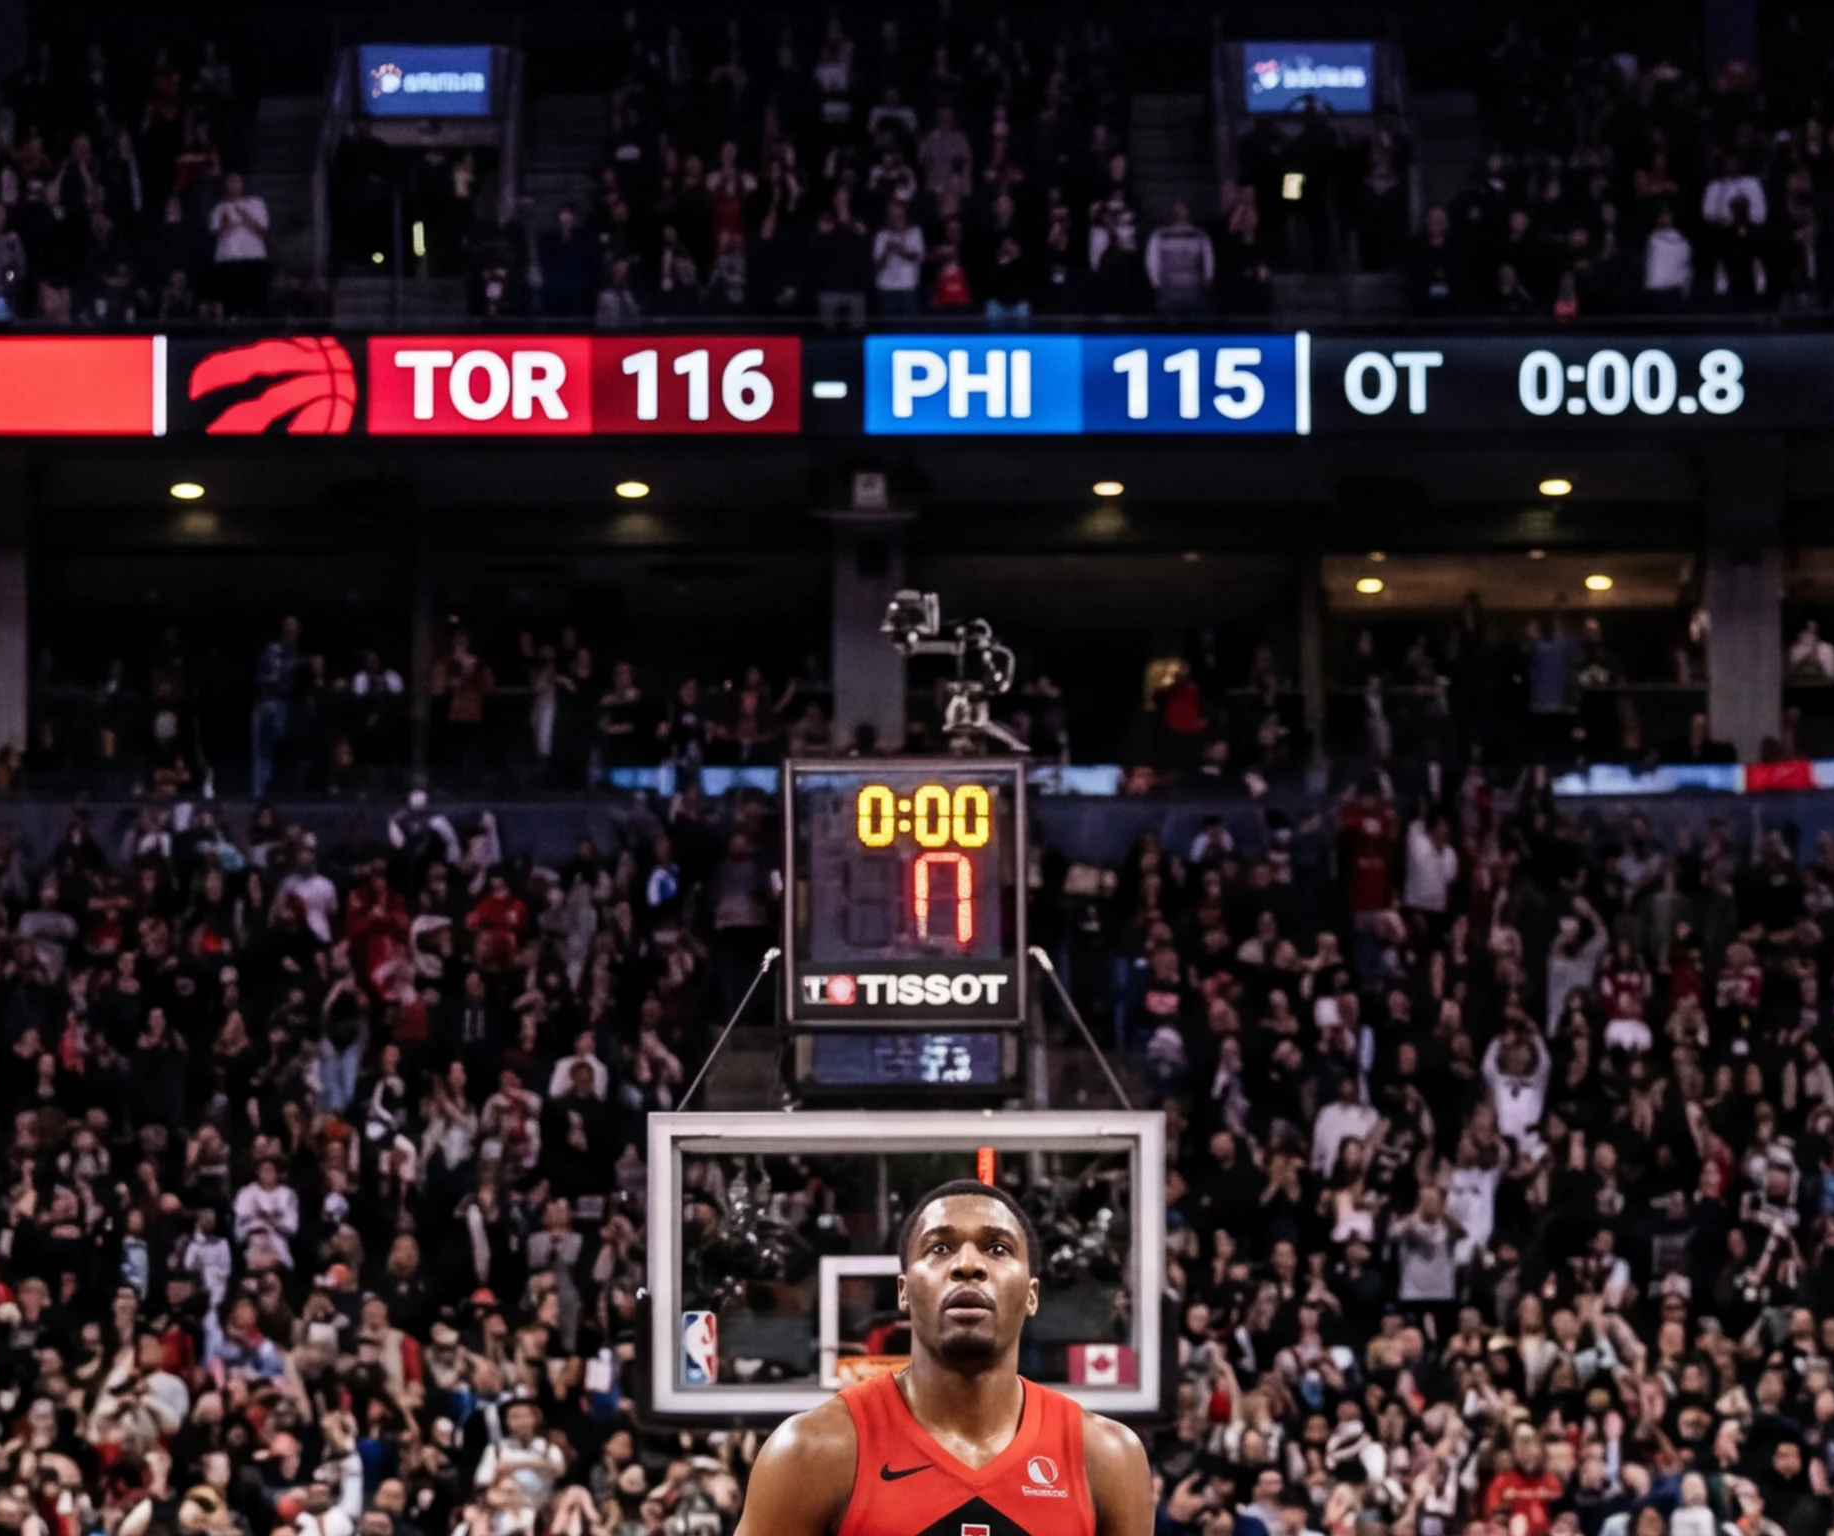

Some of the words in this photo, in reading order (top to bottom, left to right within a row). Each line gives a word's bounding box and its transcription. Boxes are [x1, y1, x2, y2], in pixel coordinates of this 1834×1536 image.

[394, 350, 569, 421] TOR
[622, 349, 774, 422] 116
[893, 350, 1031, 418] PHI
[1114, 349, 1265, 419] 115
[1344, 351, 1443, 414] OT
[1518, 349, 1745, 415] 0:00.8
[858, 785, 990, 847] 0:00
[857, 974, 1008, 1005] TISSOT
